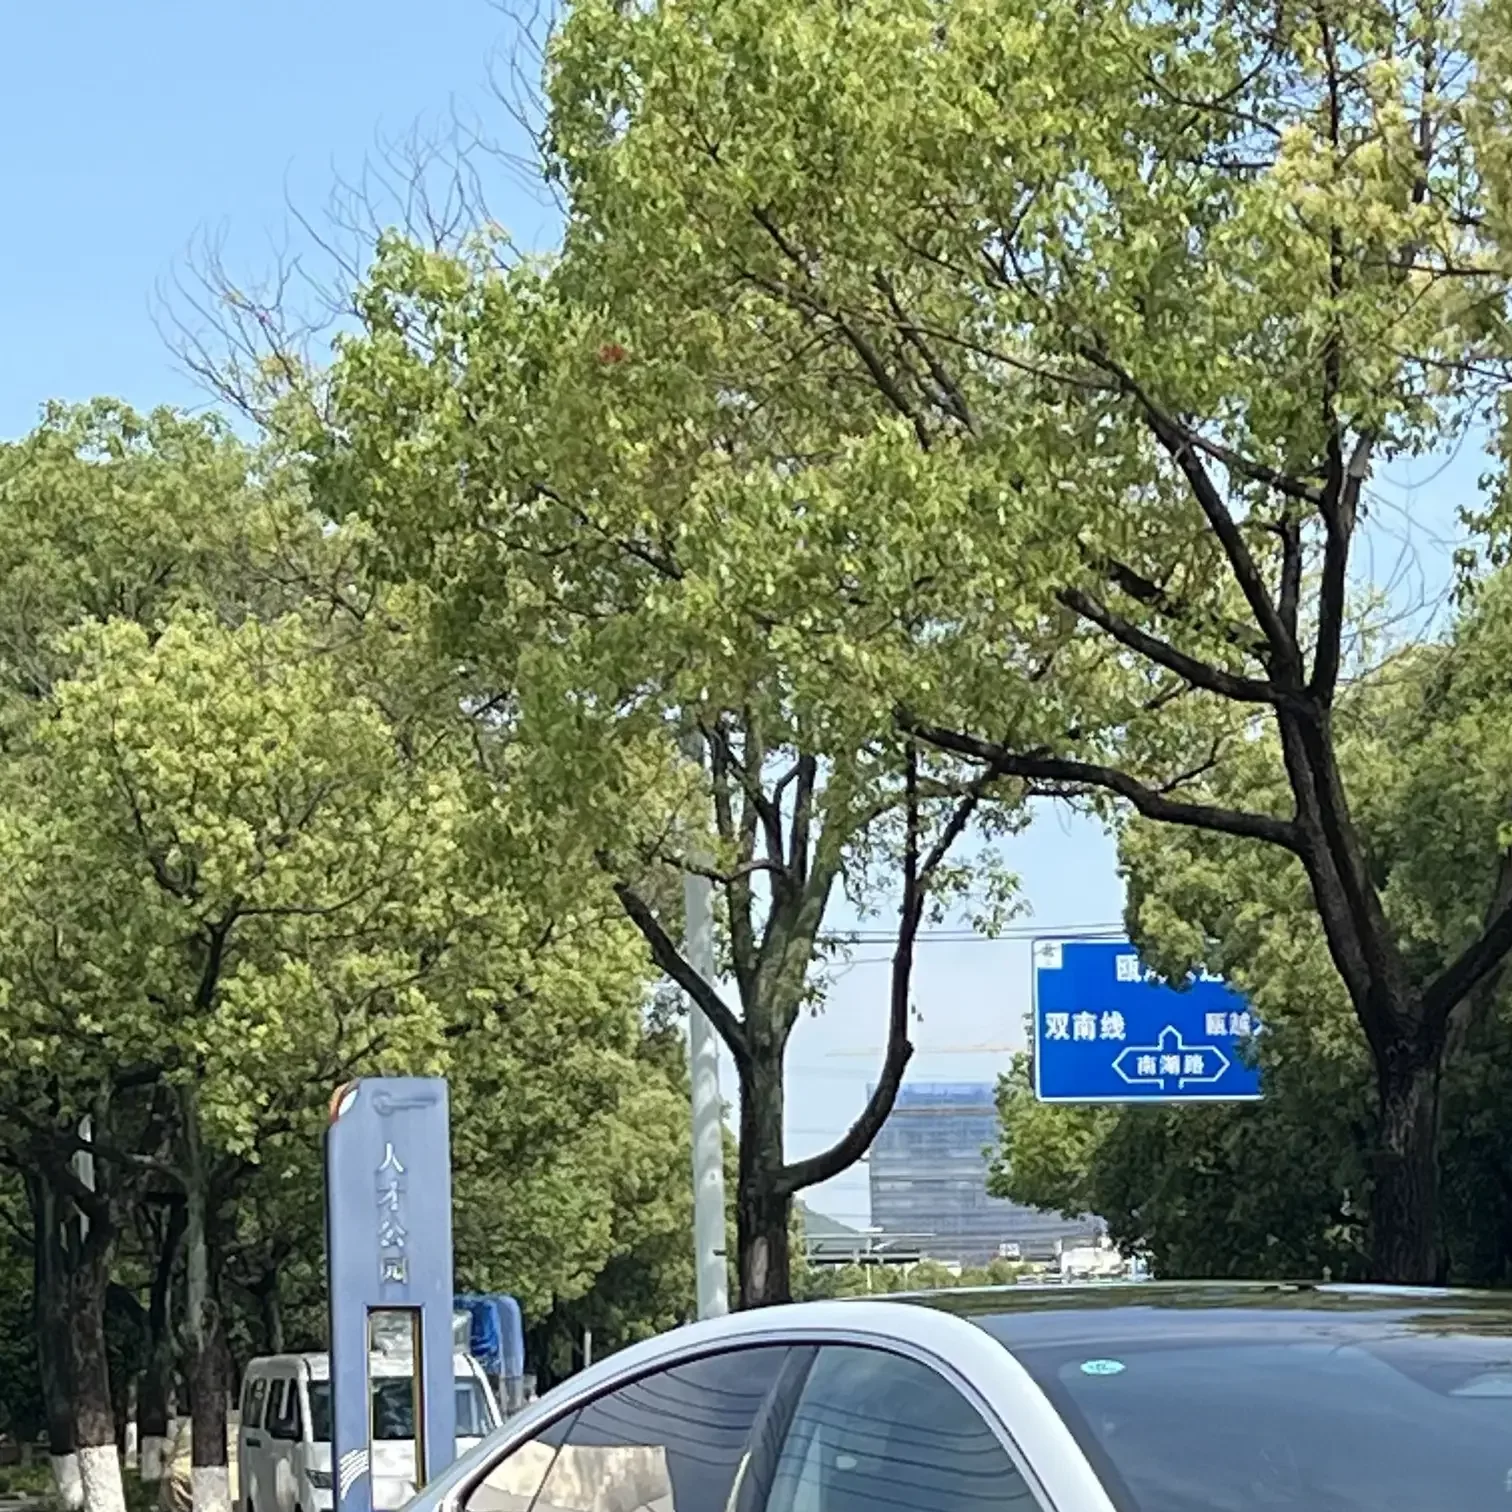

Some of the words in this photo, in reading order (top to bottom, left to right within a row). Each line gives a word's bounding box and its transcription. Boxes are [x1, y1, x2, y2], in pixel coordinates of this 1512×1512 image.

[1045, 1010, 1127, 1041] 双南线
[1205, 1012, 1264, 1036] 瓯越
[1136, 1054, 1205, 1076] 南湖路
[376, 1142, 408, 1285] 人才公园
